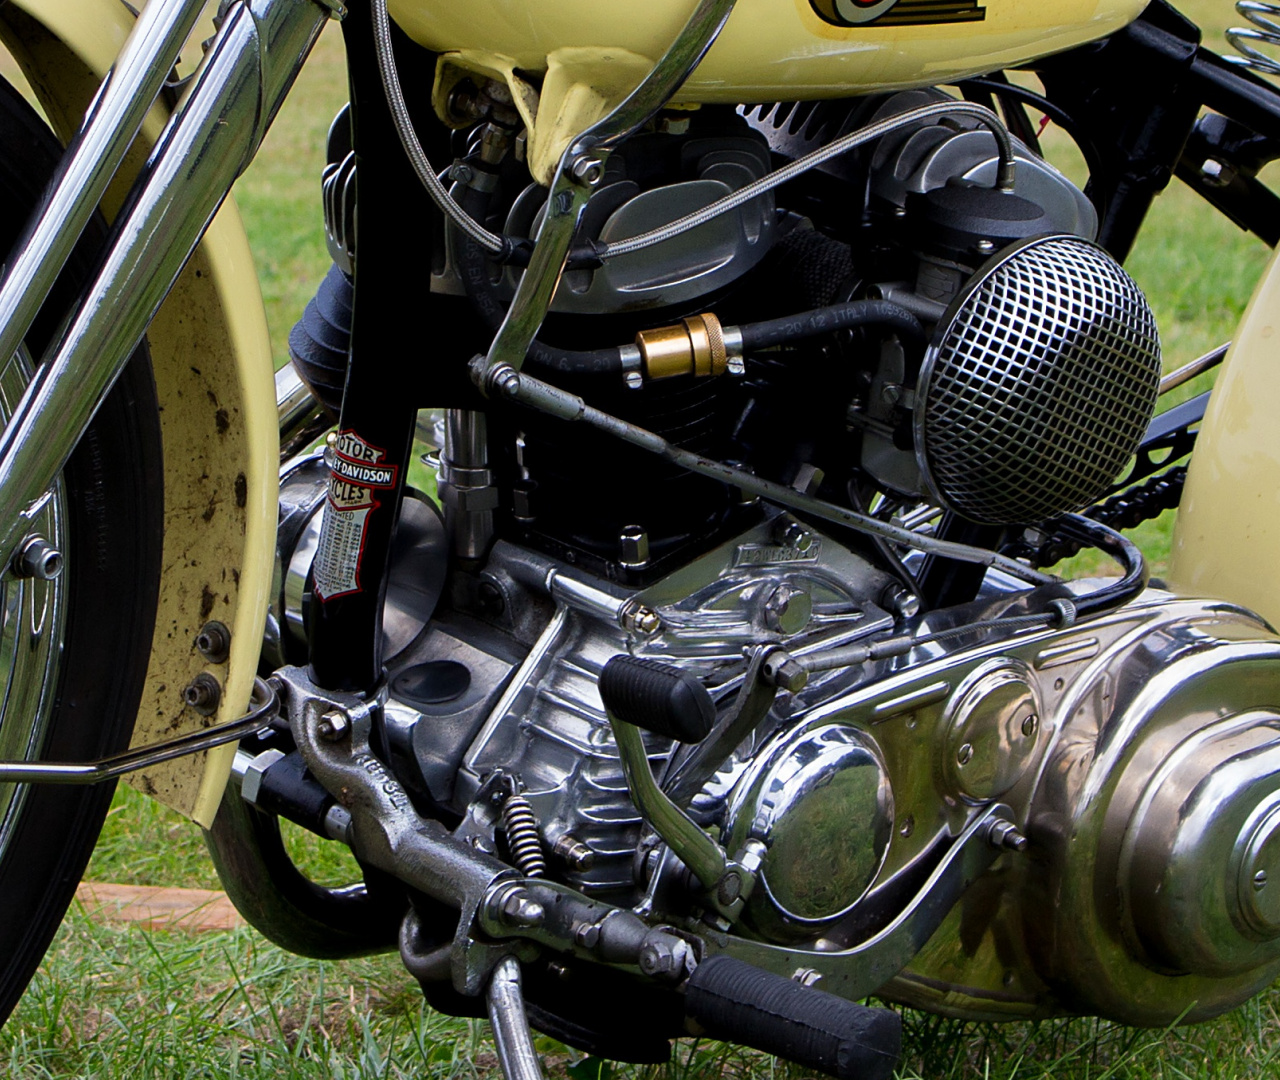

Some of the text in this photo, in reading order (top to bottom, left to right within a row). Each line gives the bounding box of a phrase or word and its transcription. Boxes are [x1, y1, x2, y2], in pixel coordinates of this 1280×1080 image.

[833, 305, 868, 325] ITALY
[337, 435, 375, 462] OTOR
[330, 477, 364, 501] YCLES
